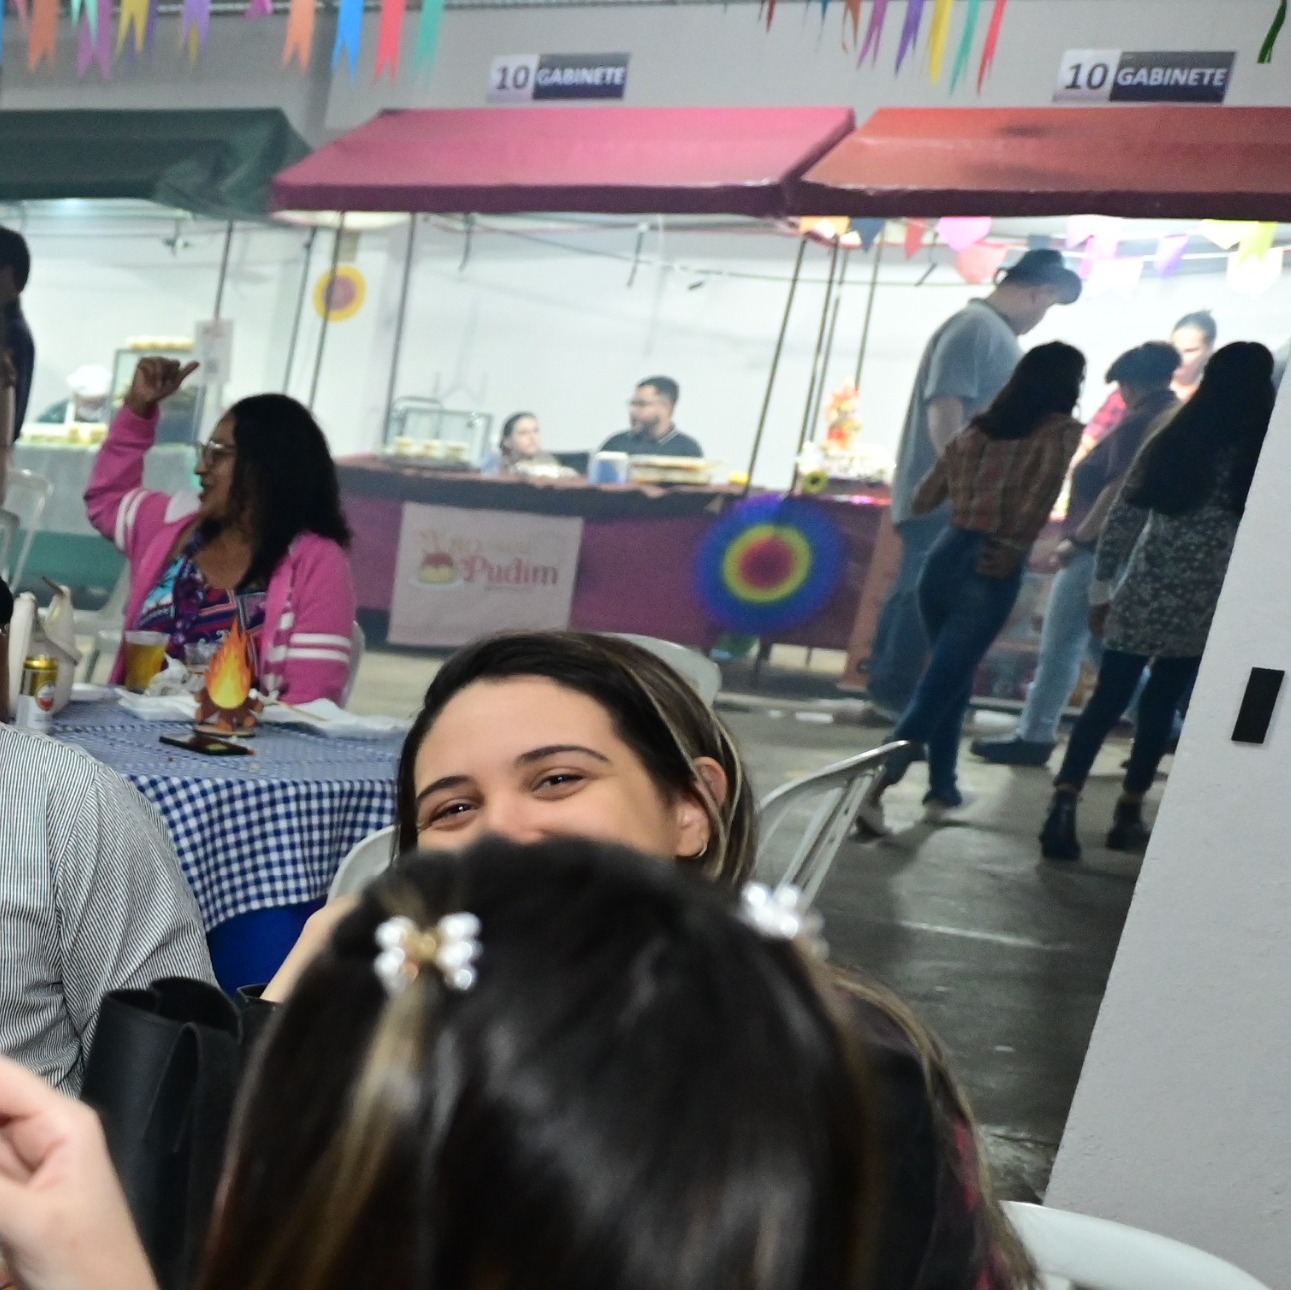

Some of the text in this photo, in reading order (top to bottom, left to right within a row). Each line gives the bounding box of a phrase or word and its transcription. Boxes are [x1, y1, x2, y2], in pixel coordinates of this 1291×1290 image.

[497, 65, 627, 90] 10 GABINETE
[1065, 63, 1229, 90] 10 GABINETE
[459, 554, 559, 585] Pudim
